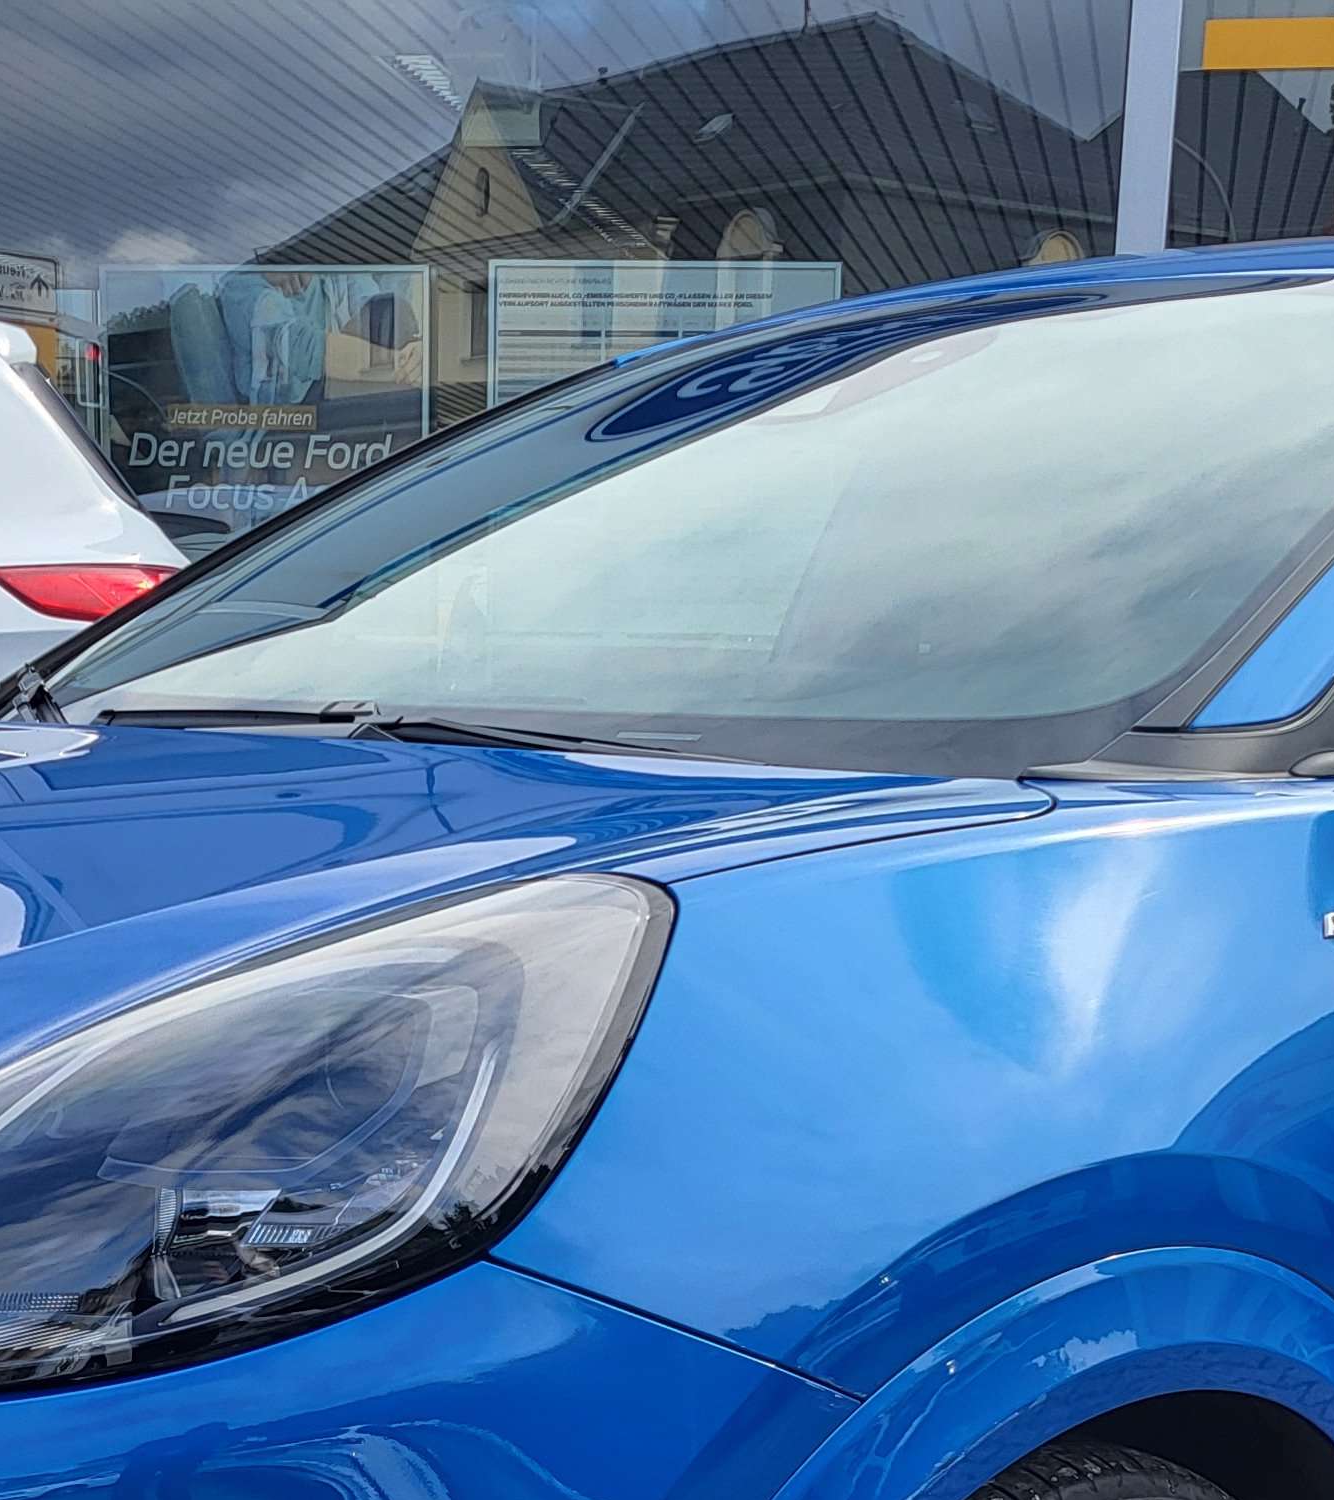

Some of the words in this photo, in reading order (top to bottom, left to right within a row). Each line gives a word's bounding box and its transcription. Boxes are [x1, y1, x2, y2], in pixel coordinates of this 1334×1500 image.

[170, 408, 207, 426] Jetzt
[210, 409, 257, 426] Probe
[260, 408, 313, 428] fahren
[128, 432, 195, 468] Der
[202, 440, 293, 469] neue
[304, 433, 392, 470] Ford
[165, 474, 275, 511] Focus
